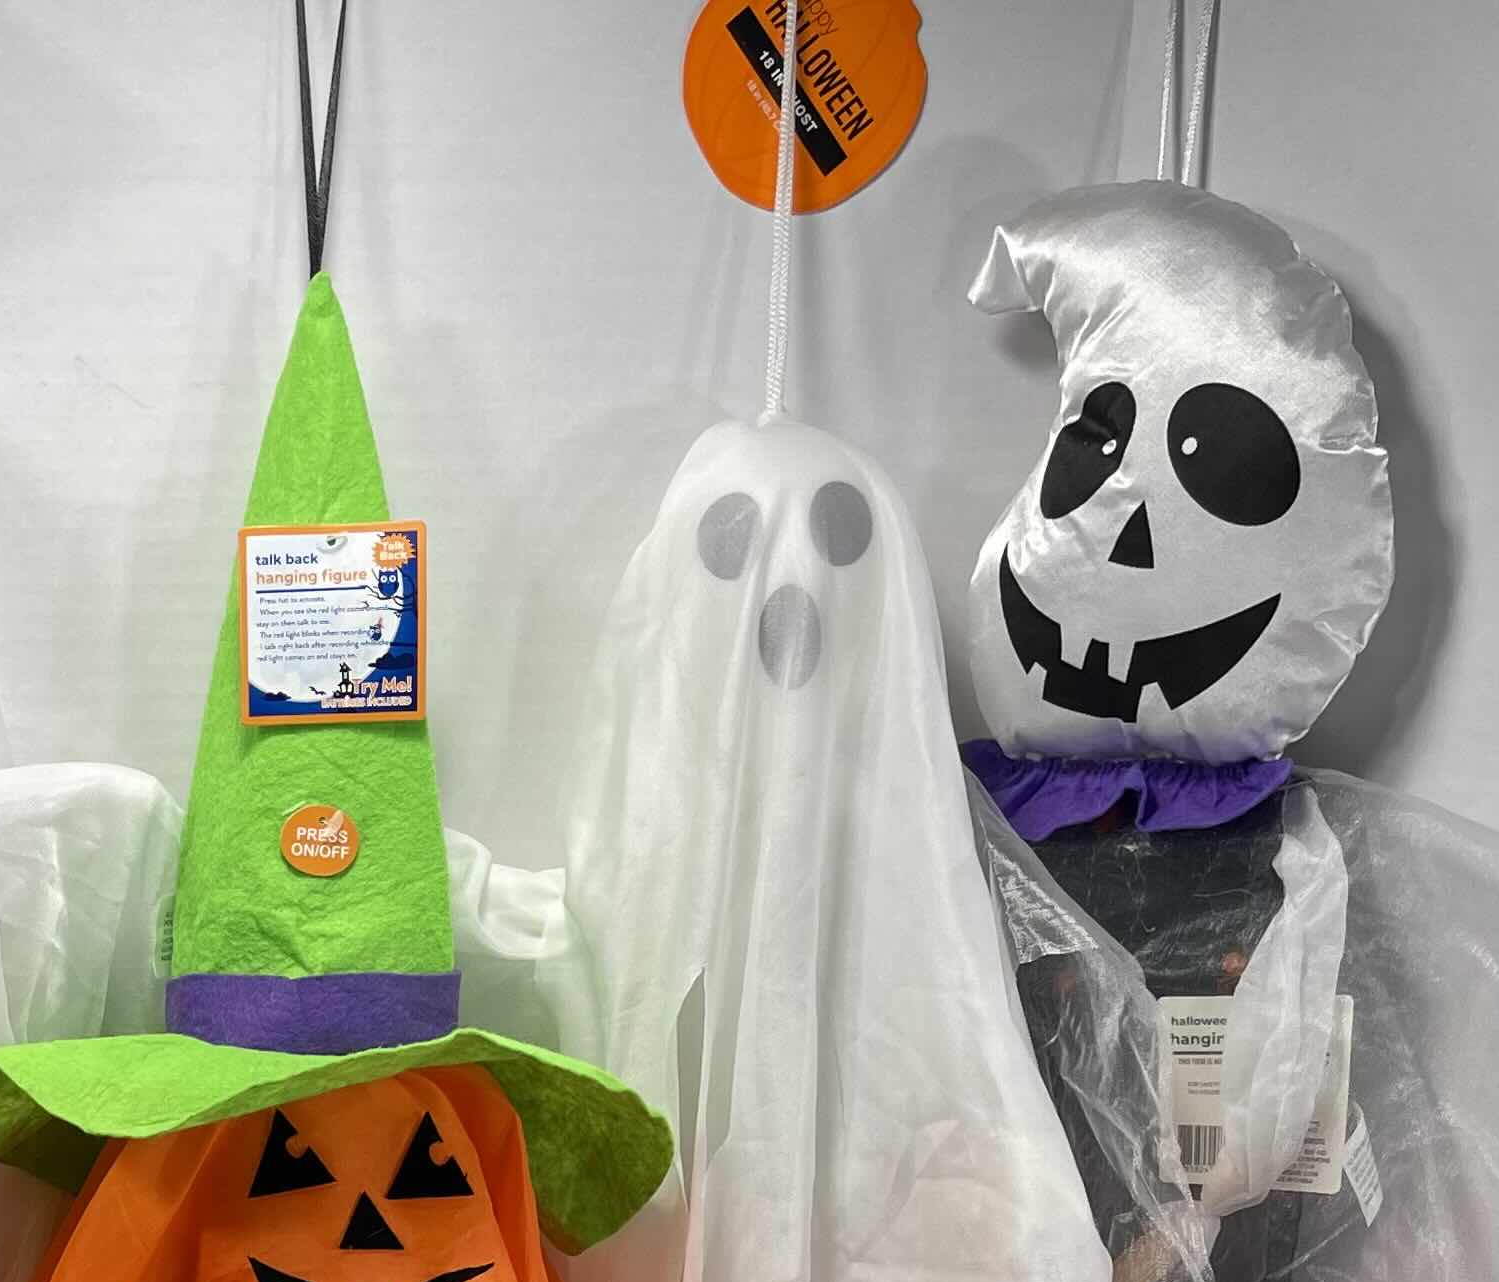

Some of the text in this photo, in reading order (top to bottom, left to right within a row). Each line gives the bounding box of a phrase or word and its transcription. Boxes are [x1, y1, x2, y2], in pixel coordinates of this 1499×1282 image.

[759, 50, 776, 69] 18
[793, 93, 819, 133] HOST
[256, 553, 318, 565] talk back
[257, 568, 367, 586] hanging figure
[352, 676, 413, 698] Try Me!
[296, 827, 348, 843] PRESS
[291, 842, 350, 860] ON/OFF
[1171, 1016, 1228, 1026] hallowee
[1171, 1031, 1224, 1048] hangin
